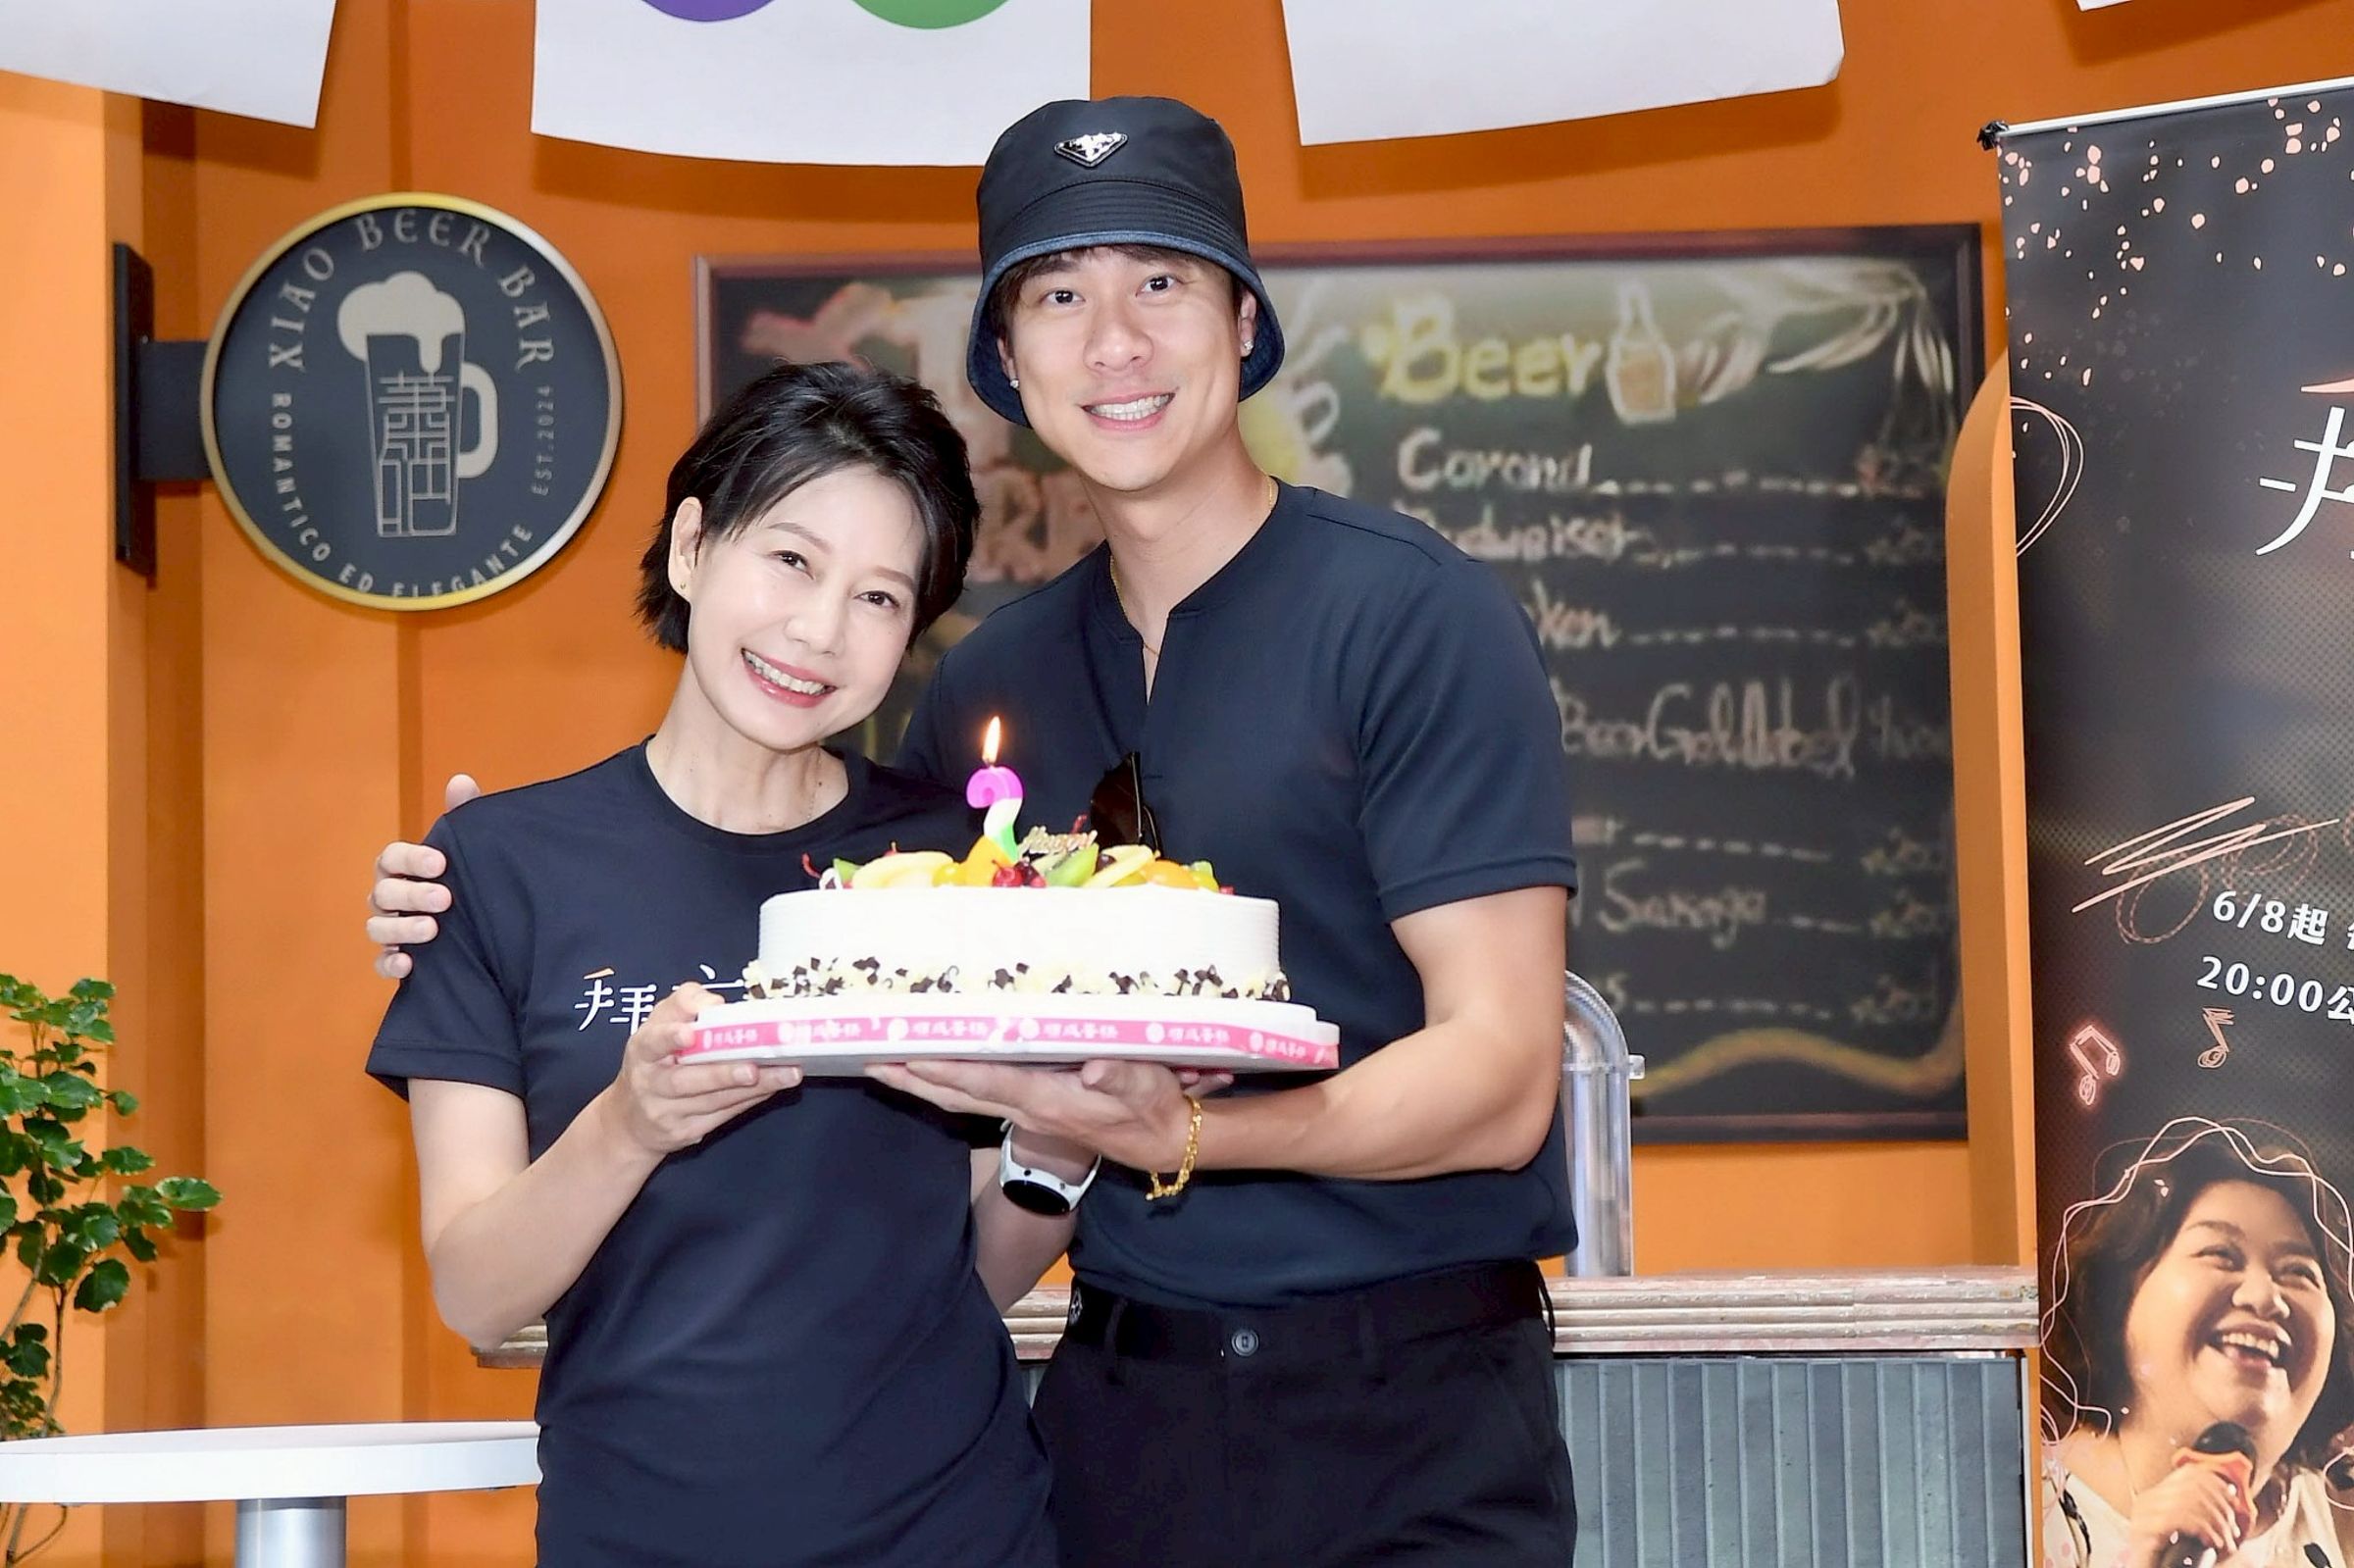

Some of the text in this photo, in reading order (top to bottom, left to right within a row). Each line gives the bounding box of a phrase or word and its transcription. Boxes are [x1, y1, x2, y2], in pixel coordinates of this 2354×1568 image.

[269, 208, 555, 373] XIAO BEER BAR
[1377, 294, 1603, 403] Beer
[270, 392, 534, 599] ROMANTICO ED ELEGANTE
[2213, 889, 2328, 946] 6/8起
